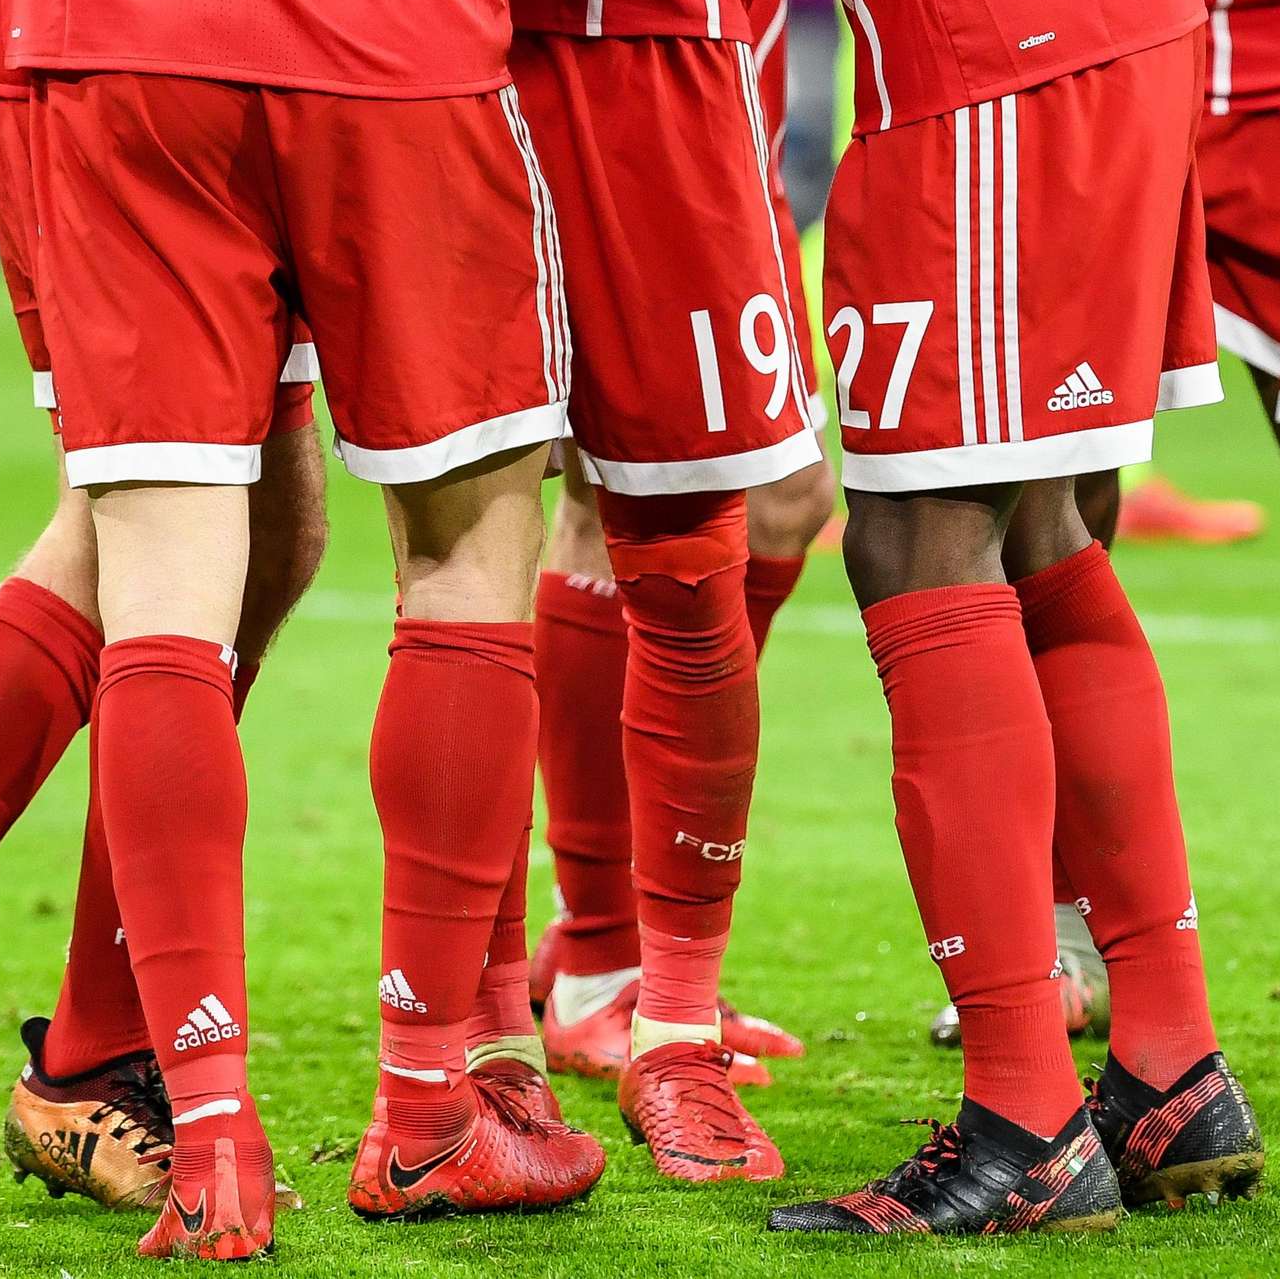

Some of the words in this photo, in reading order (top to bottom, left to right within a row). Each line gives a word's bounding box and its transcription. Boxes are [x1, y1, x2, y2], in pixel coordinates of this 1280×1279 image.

[689, 292, 793, 433] 19
[826, 300, 935, 430] 27
[1046, 389, 1115, 412] adidas
[674, 830, 746, 862] FCB
[173, 1022, 242, 1052] adidas
